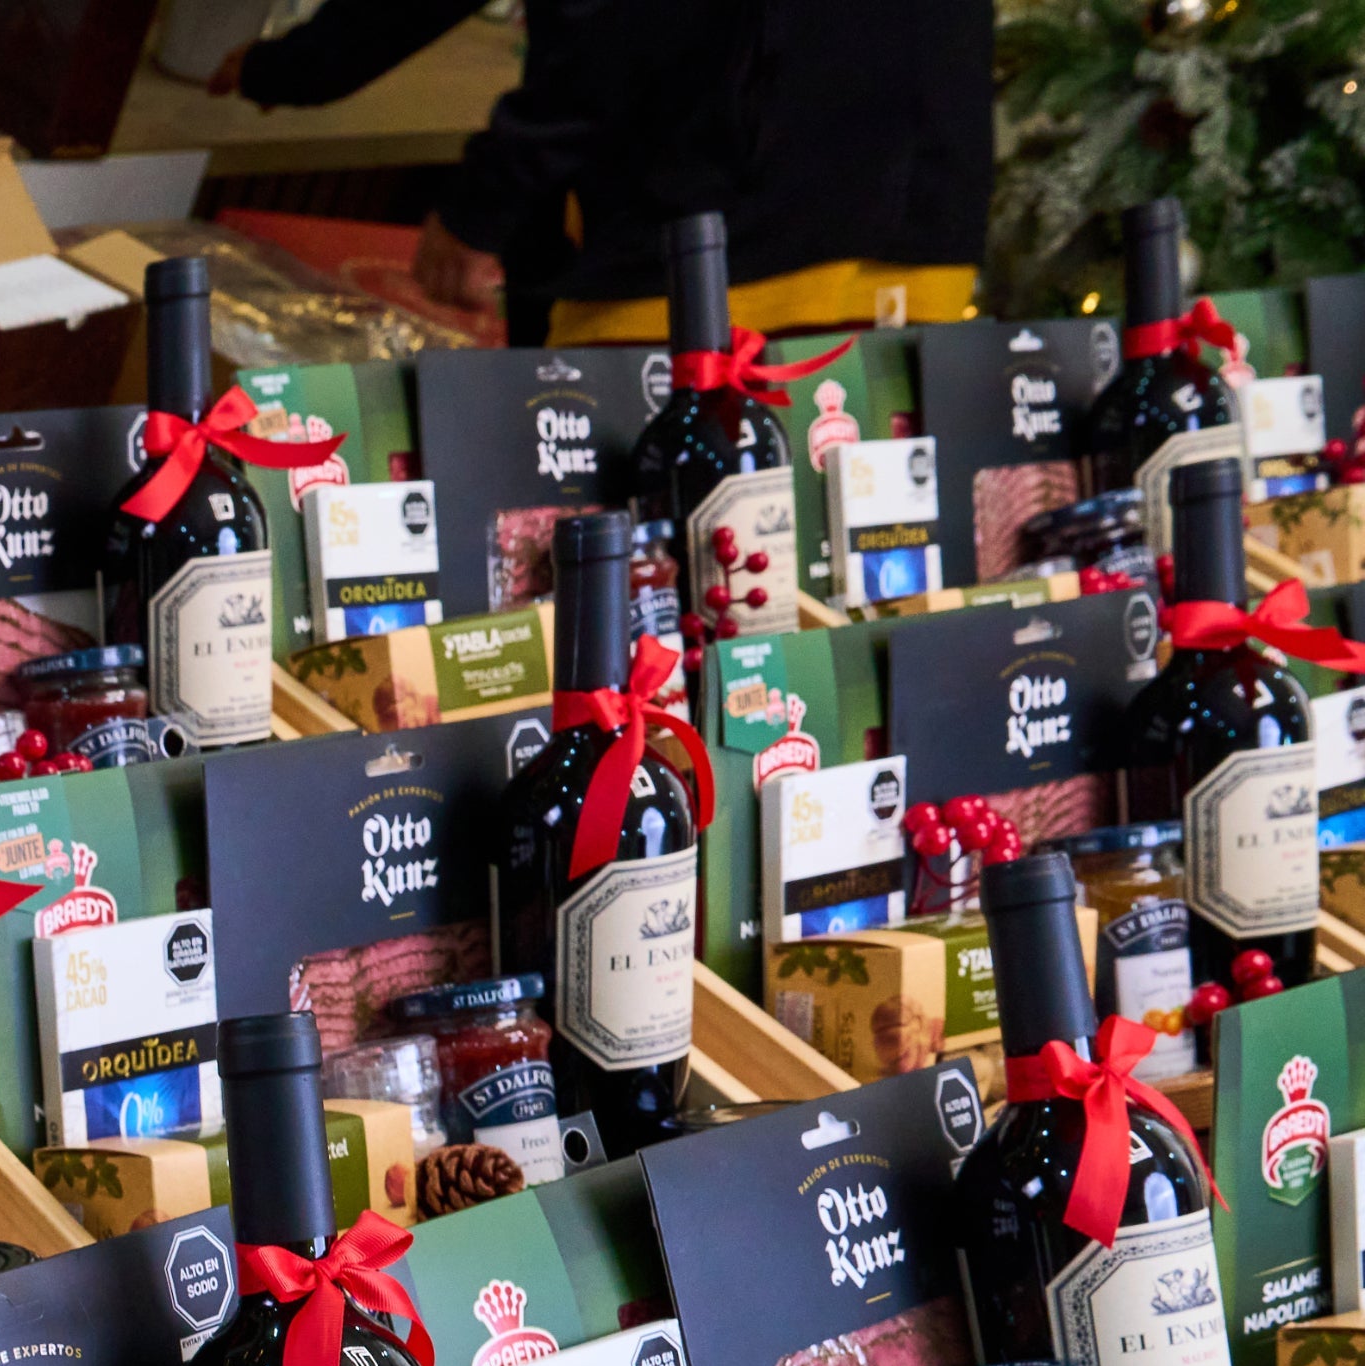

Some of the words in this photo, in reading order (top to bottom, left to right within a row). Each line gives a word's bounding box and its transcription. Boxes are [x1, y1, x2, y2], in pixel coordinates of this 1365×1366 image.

[536, 408, 590, 442] Otto
[1009, 675, 1067, 713] Otto
[1006, 713, 1071, 757] Kunz
[362, 812, 432, 857] Otto
[361, 857, 438, 906] Kunz
[43, 897, 112, 932] BRAEDT
[1269, 1112, 1326, 1152] BRAEDT
[818, 1182, 888, 1235] Otto
[180, 1264, 204, 1282] ALTO
[205, 1257, 219, 1272] EN
[825, 1228, 905, 1289] Kunz
[187, 1278, 218, 1299] SODIO
